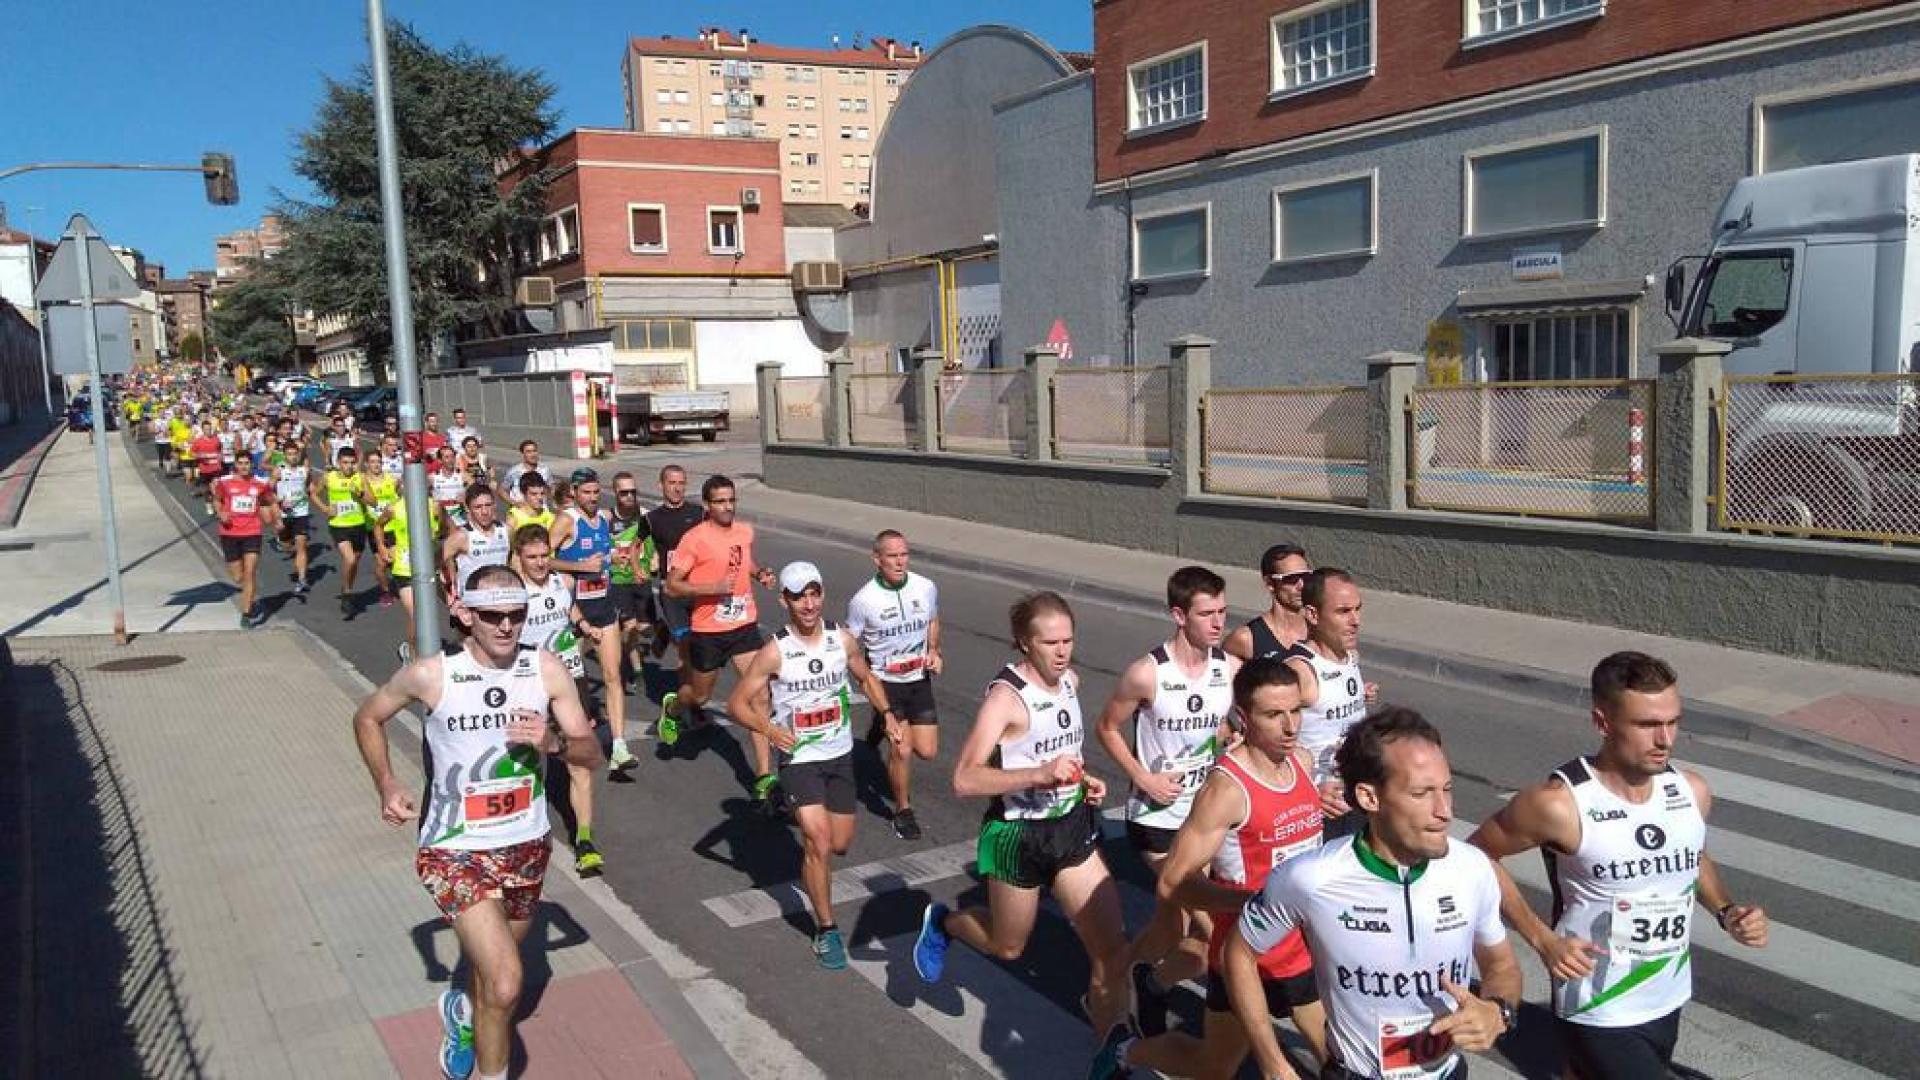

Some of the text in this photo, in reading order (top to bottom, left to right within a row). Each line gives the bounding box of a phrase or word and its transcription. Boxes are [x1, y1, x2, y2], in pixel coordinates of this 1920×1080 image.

[1157, 713, 1221, 732] etxenik
[486, 793, 515, 816] 59
[1630, 914, 1686, 943] 348
[1337, 957, 1469, 998] etxenik
